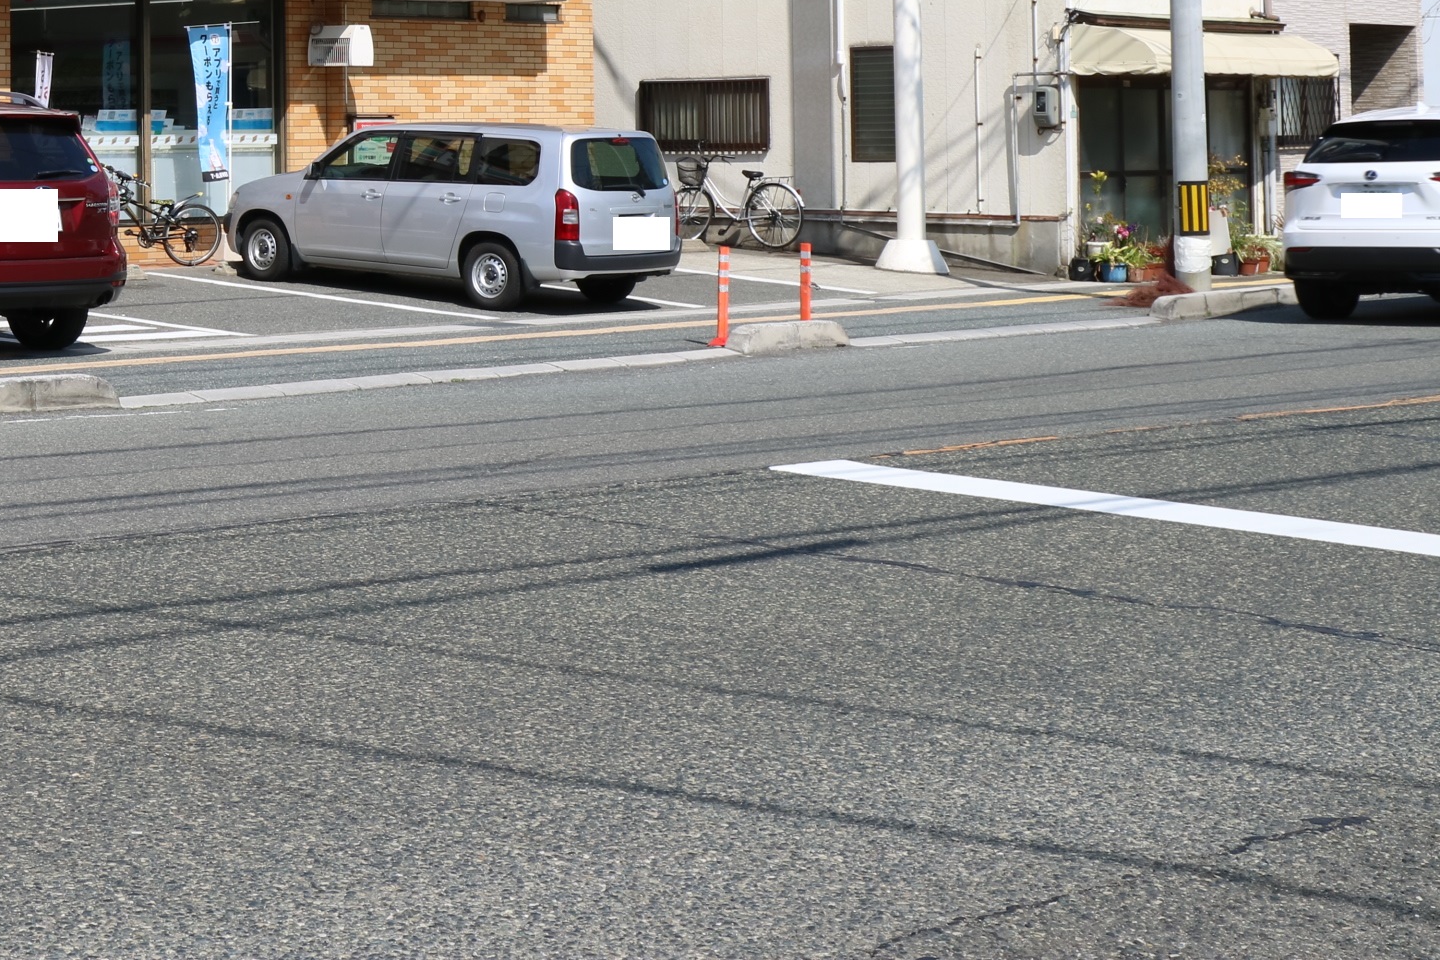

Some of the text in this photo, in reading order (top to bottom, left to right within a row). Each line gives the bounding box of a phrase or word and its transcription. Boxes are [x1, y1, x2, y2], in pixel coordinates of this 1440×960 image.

[200, 34, 216, 126] クーポンもらえる
